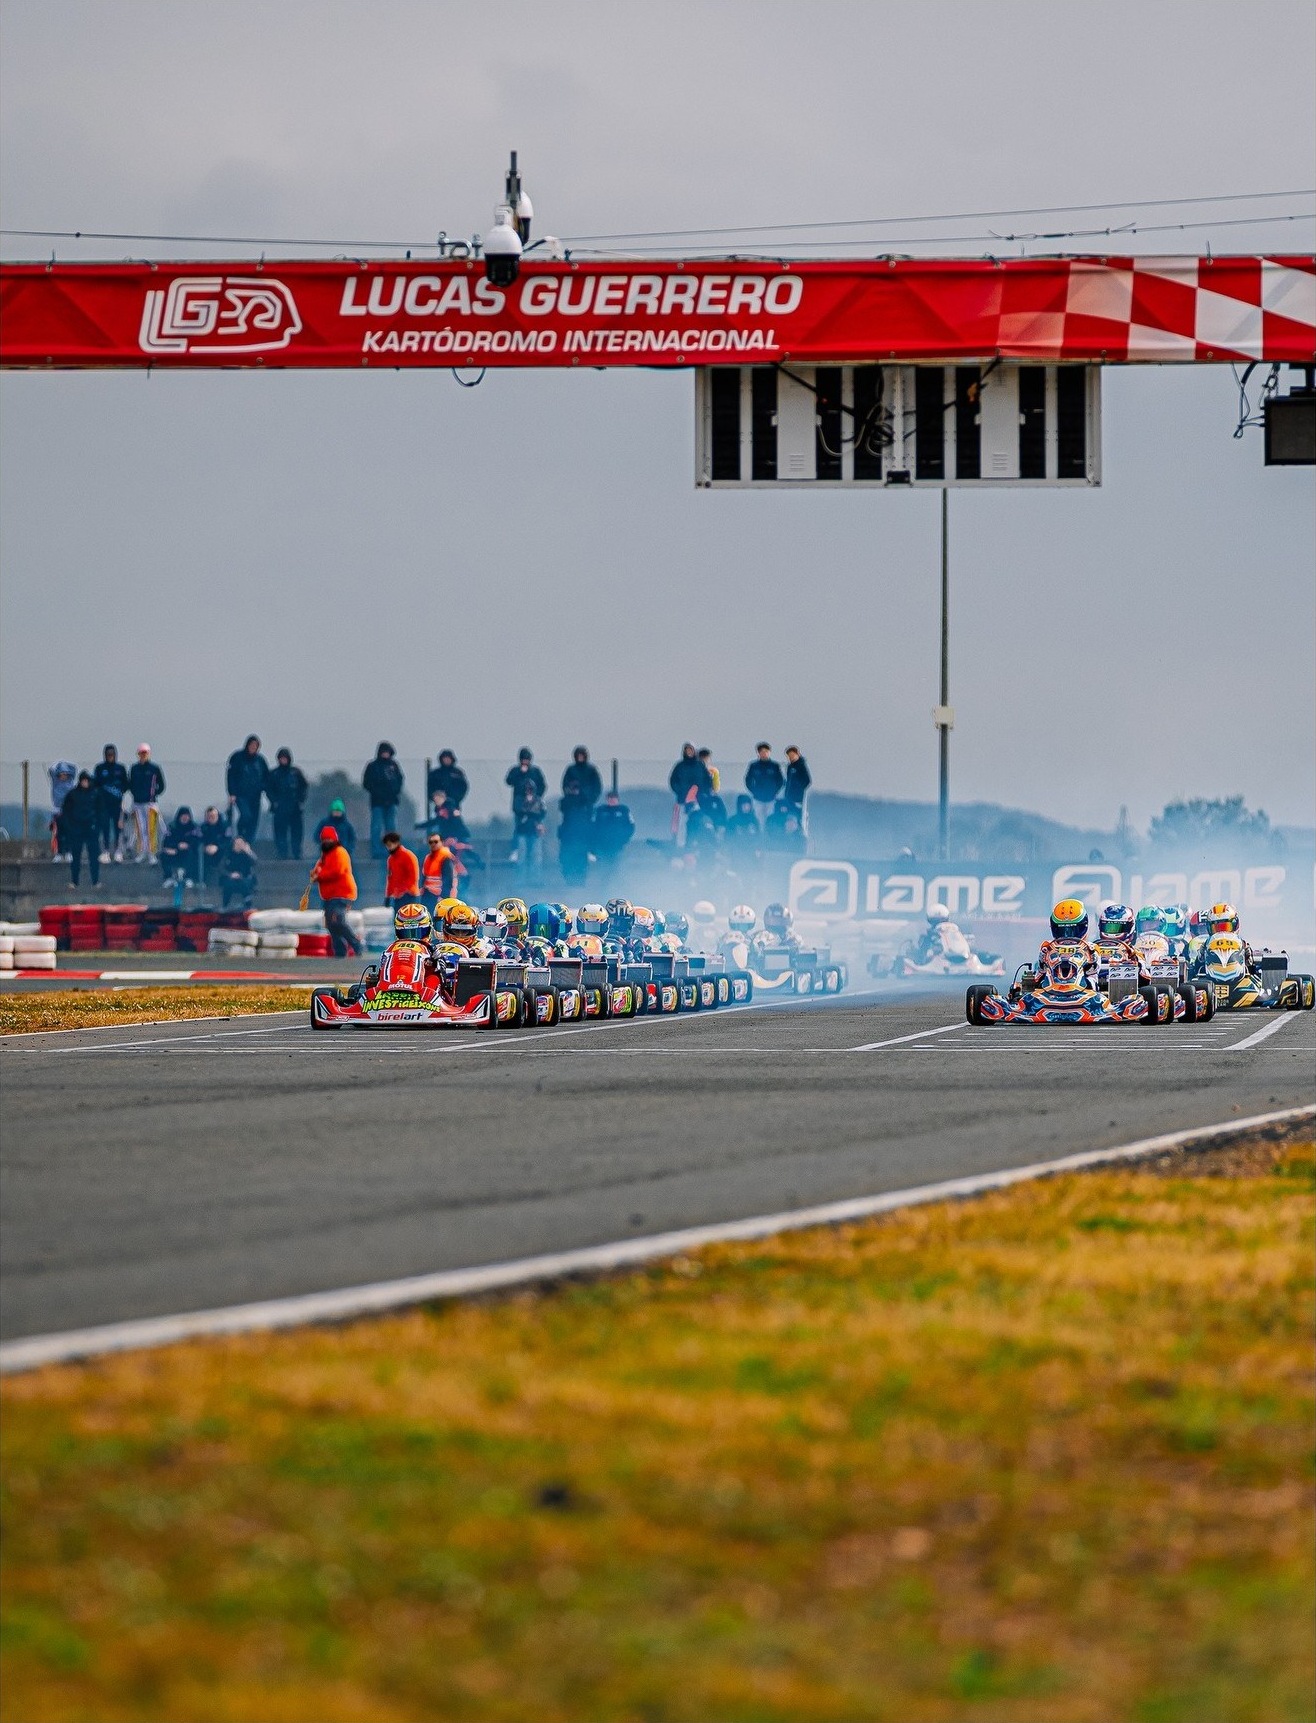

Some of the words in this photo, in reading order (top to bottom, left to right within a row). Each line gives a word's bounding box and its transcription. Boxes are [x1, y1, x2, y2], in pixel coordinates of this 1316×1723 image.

[339, 276, 506, 316] LUCAS
[519, 275, 803, 316] GUERRERO
[362, 325, 557, 353] KARTÓDROMO
[562, 326, 780, 352] INTERNACIONAL
